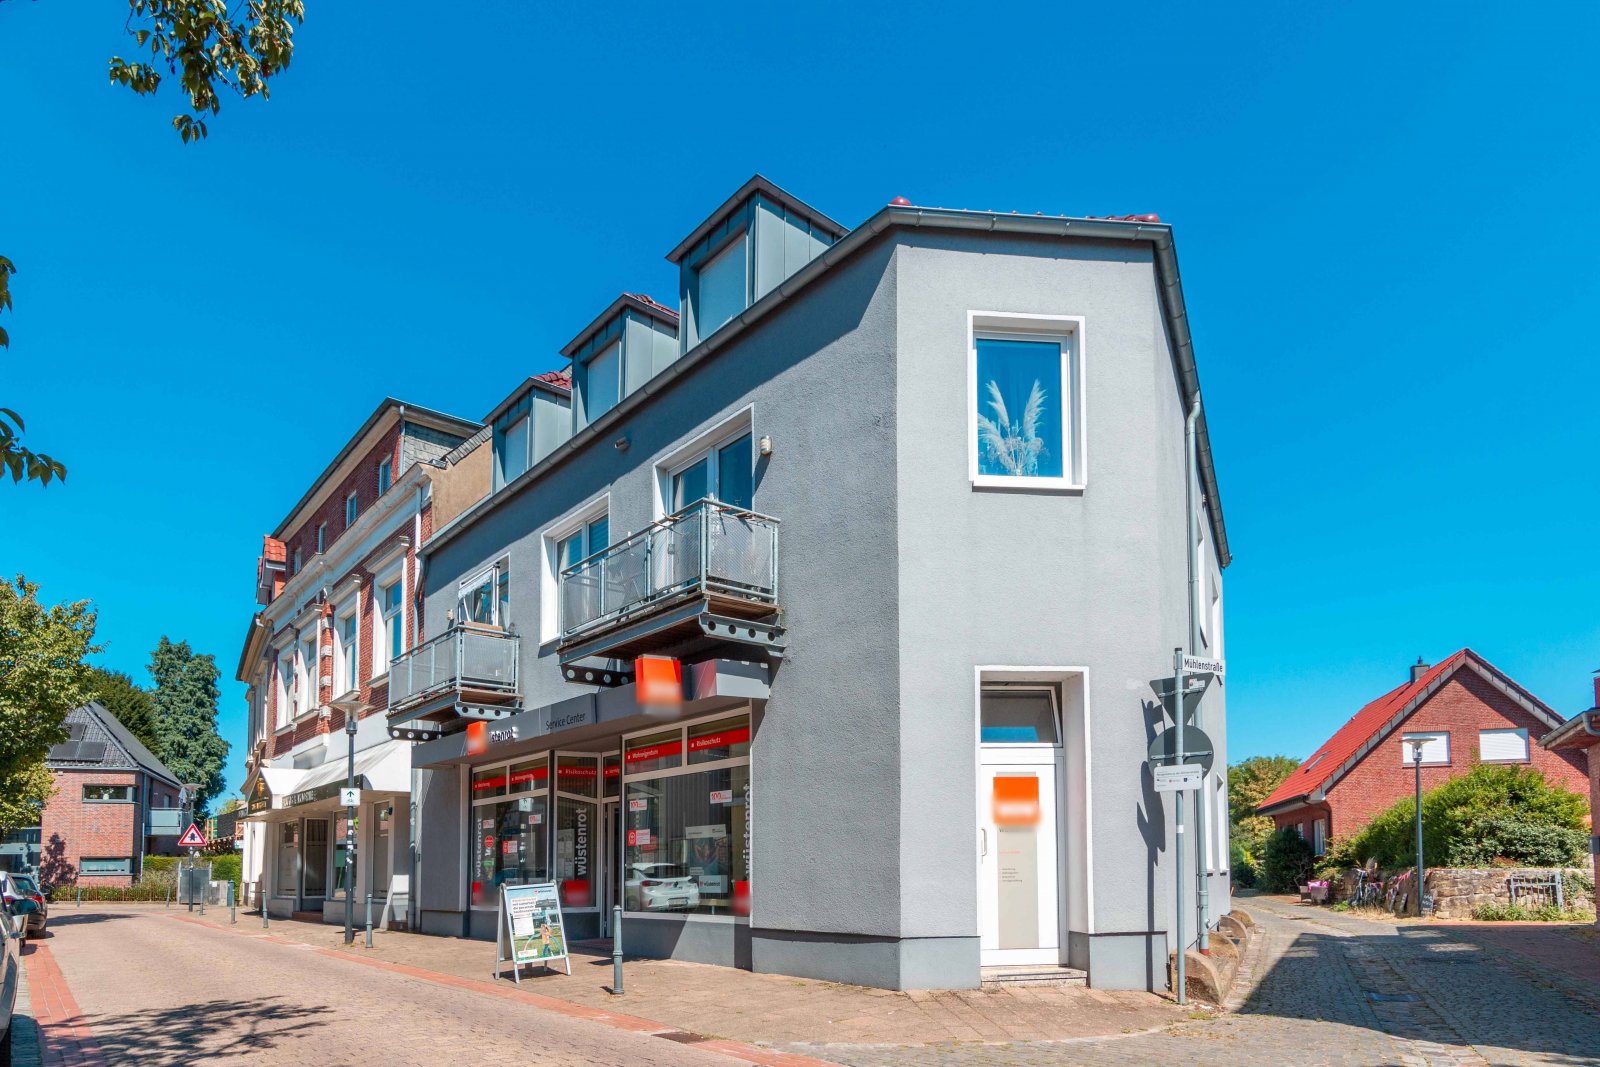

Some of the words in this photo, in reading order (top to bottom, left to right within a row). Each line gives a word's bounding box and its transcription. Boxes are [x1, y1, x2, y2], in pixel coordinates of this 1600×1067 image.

[1183, 657, 1224, 673] Mühlenstraße
[545, 718, 566, 731] Service
[566, 711, 586, 725] Center
[475, 817, 483, 879] wüstenrot
[574, 807, 588, 876] wüstenrot
